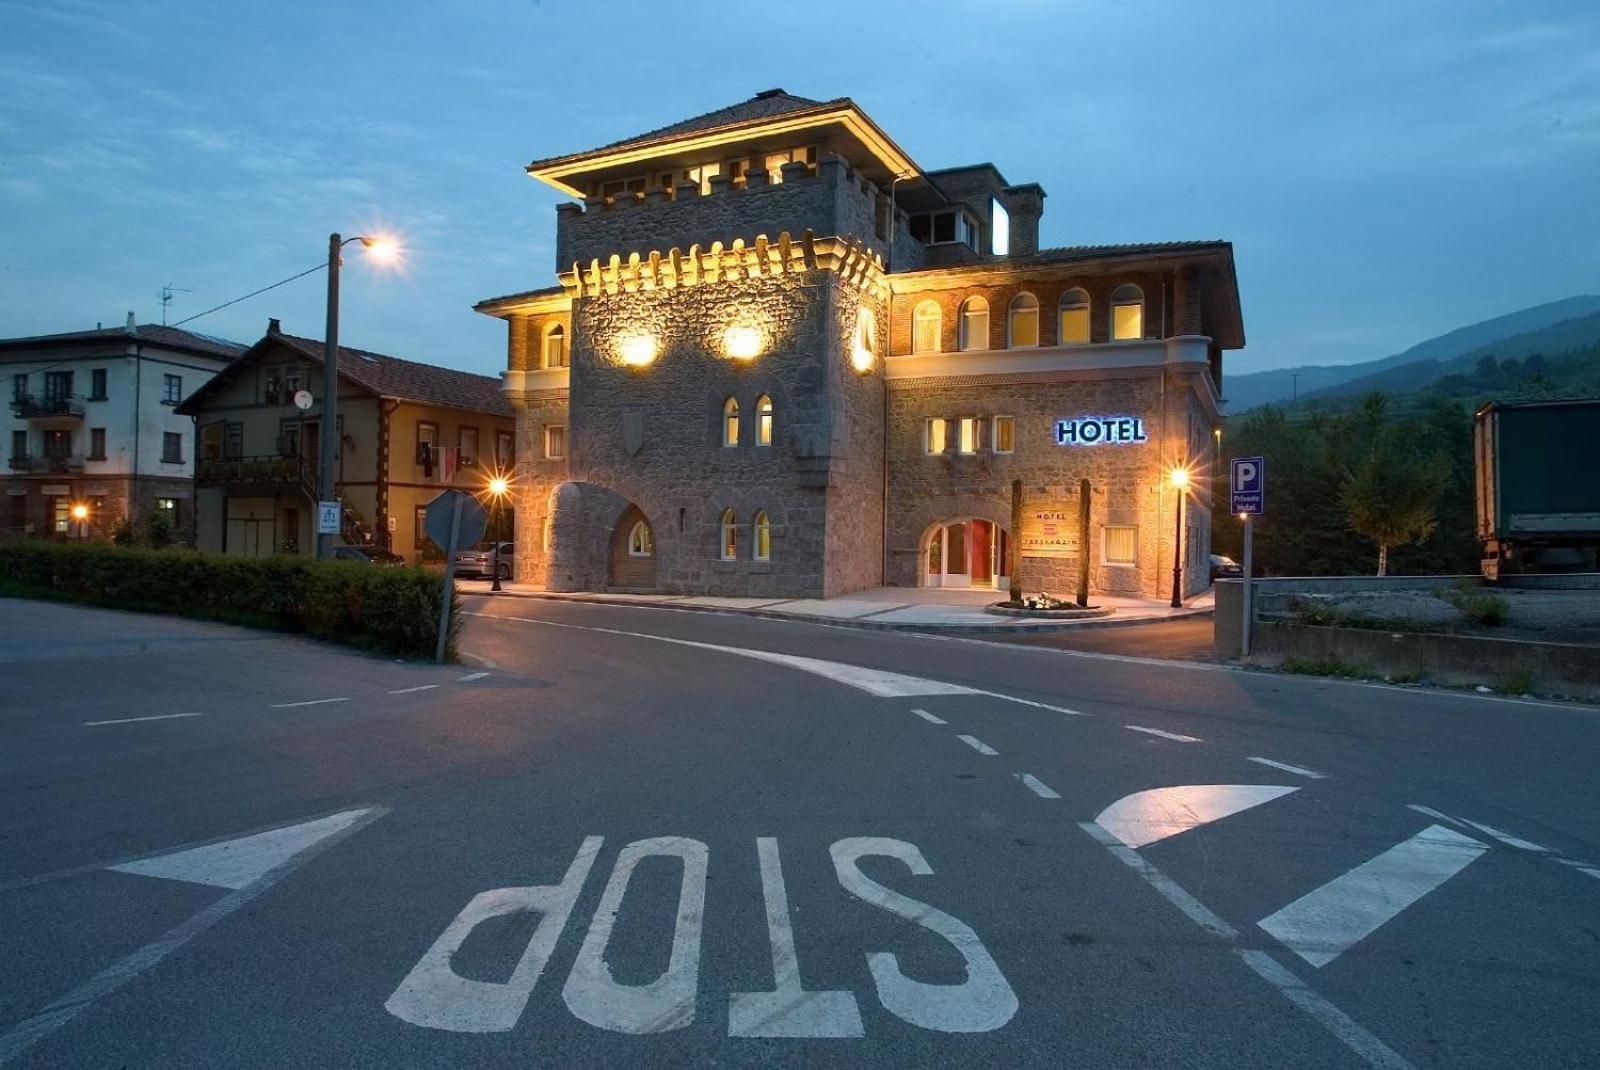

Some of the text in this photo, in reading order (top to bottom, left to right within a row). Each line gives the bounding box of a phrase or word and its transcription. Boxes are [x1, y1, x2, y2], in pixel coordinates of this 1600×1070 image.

[1058, 419, 1146, 442] HOTEL
[1237, 463, 1256, 490] P
[385, 836, 1018, 1037] STOP
